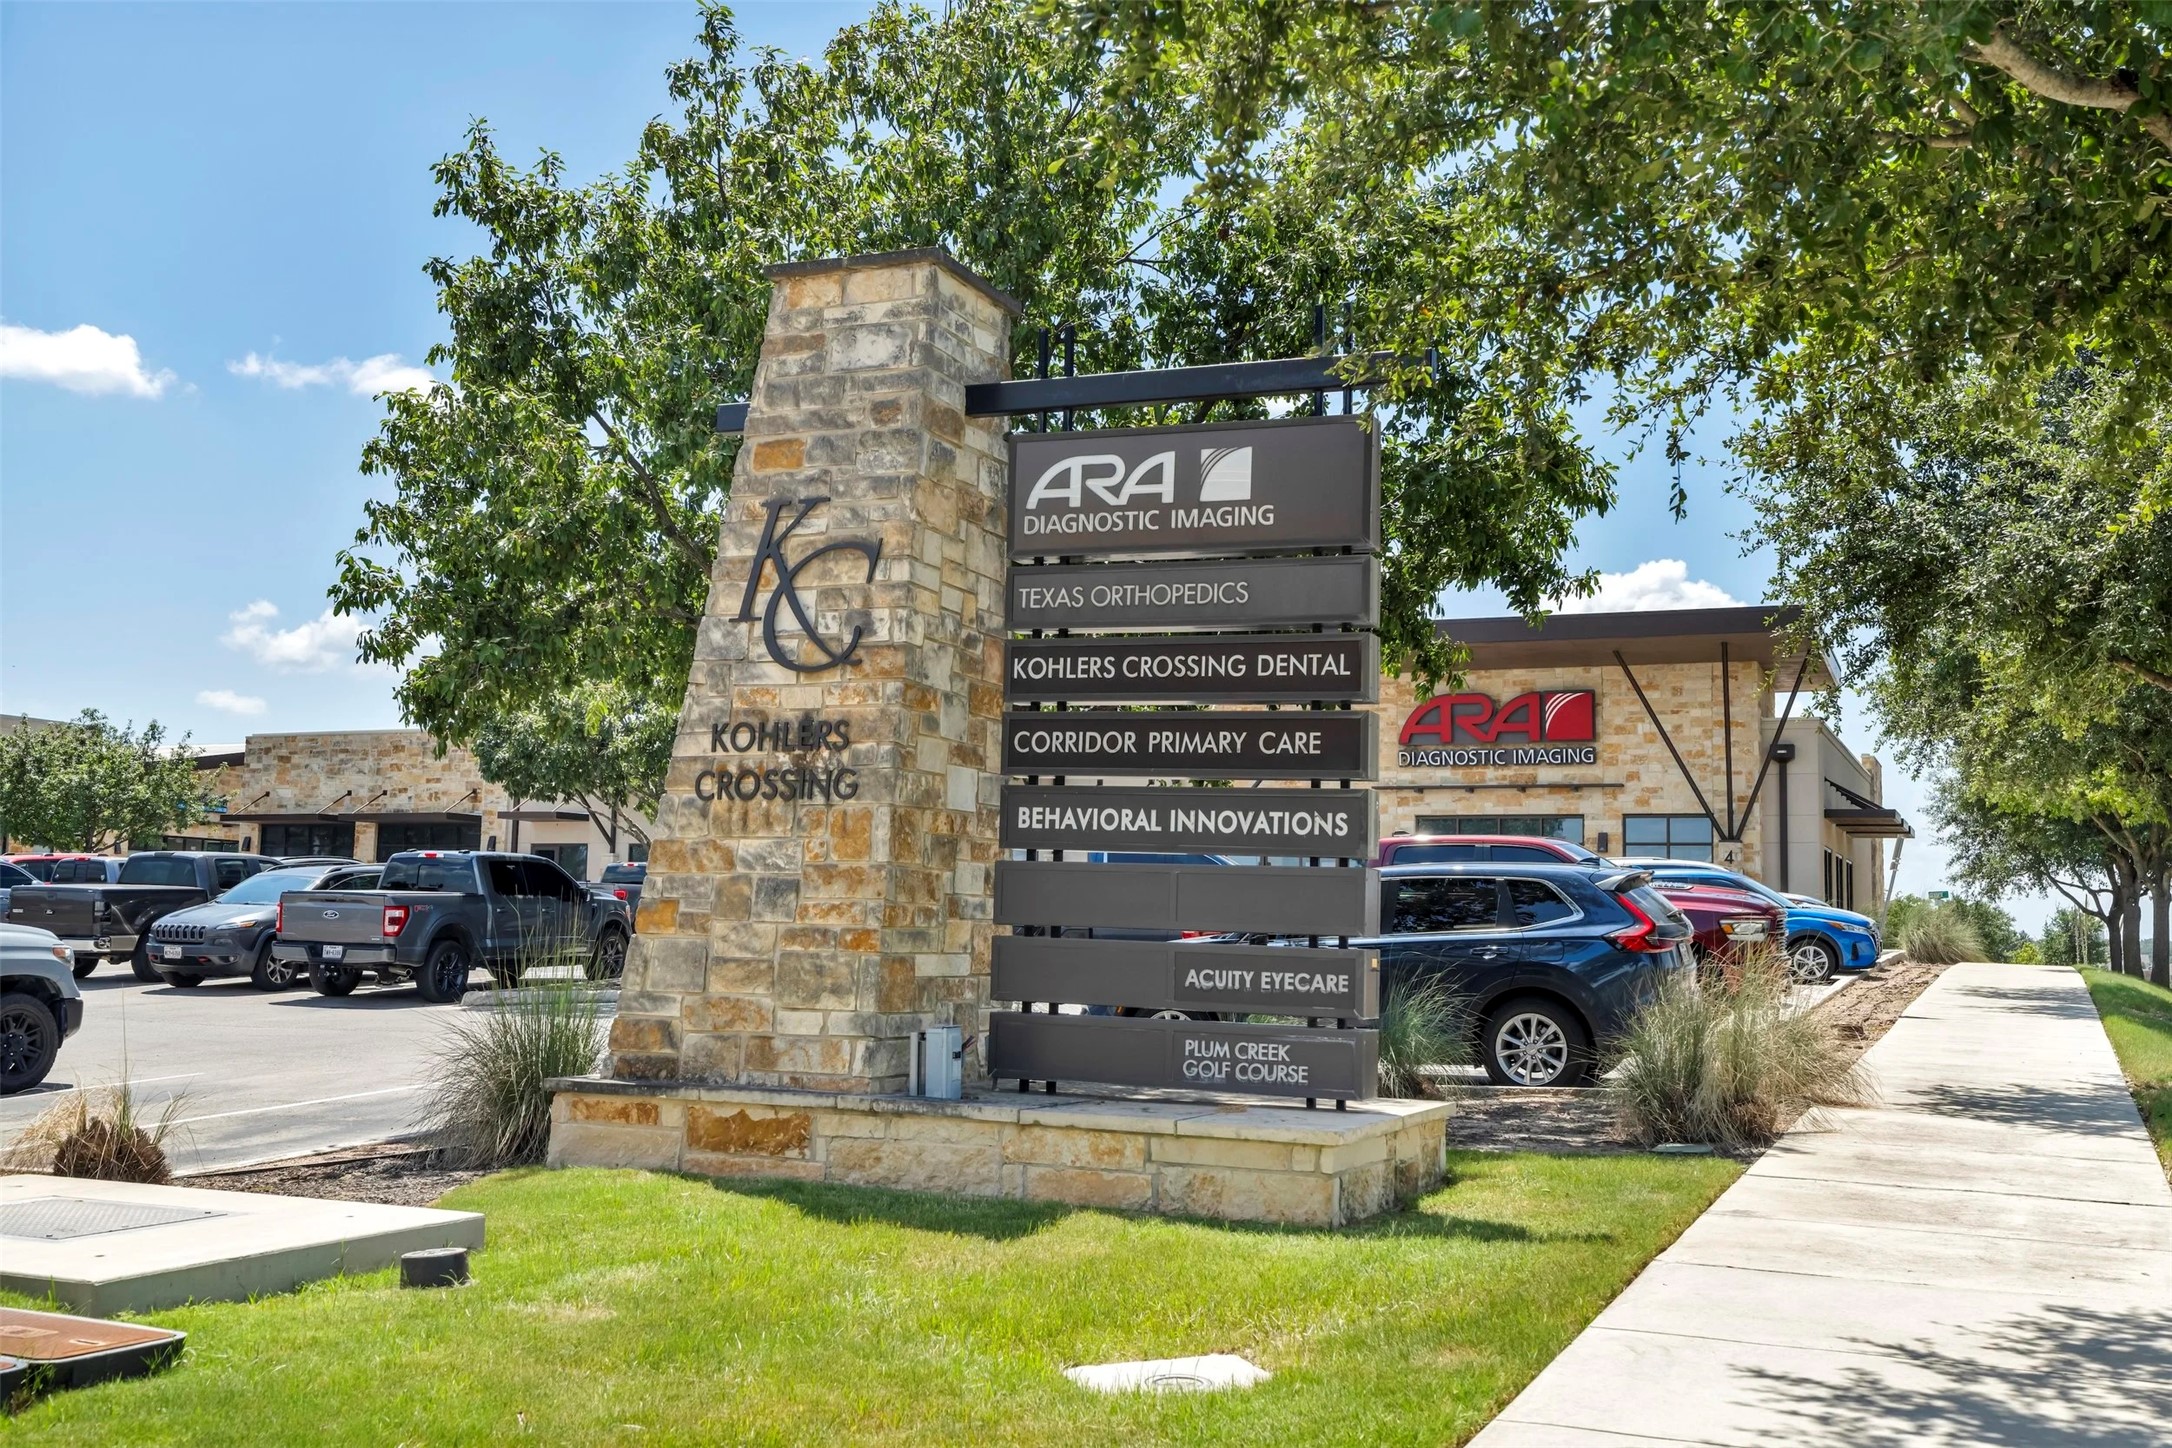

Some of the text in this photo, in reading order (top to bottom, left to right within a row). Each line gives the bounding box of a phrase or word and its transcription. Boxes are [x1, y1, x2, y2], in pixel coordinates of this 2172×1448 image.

[1026, 451, 1175, 509] ARA
[1024, 505, 1274, 535] DIAGNOSTIC IMAGING
[1019, 582, 1249, 609] TEXAS ORTHOPEDICS
[1014, 653, 1351, 680] KOHLERS CROSSING DENTAL
[1399, 692, 1541, 744] ARA
[711, 720, 850, 752] KOHLERS
[1014, 731, 1322, 755] CORRIDOR PRIMARY CARE
[1398, 747, 1595, 767] DIAGNOSTIC IMAGING
[694, 768, 859, 801] CROSSING
[1017, 806, 1348, 836] BEHAVIORAL INNOVATIONS
[1724, 850, 1734, 864] 4
[1184, 969, 1349, 993] ACUITY EYECARE
[1184, 1039, 1290, 1062] PLUM CREEK
[1182, 1059, 1309, 1084] GOLF COURSE
